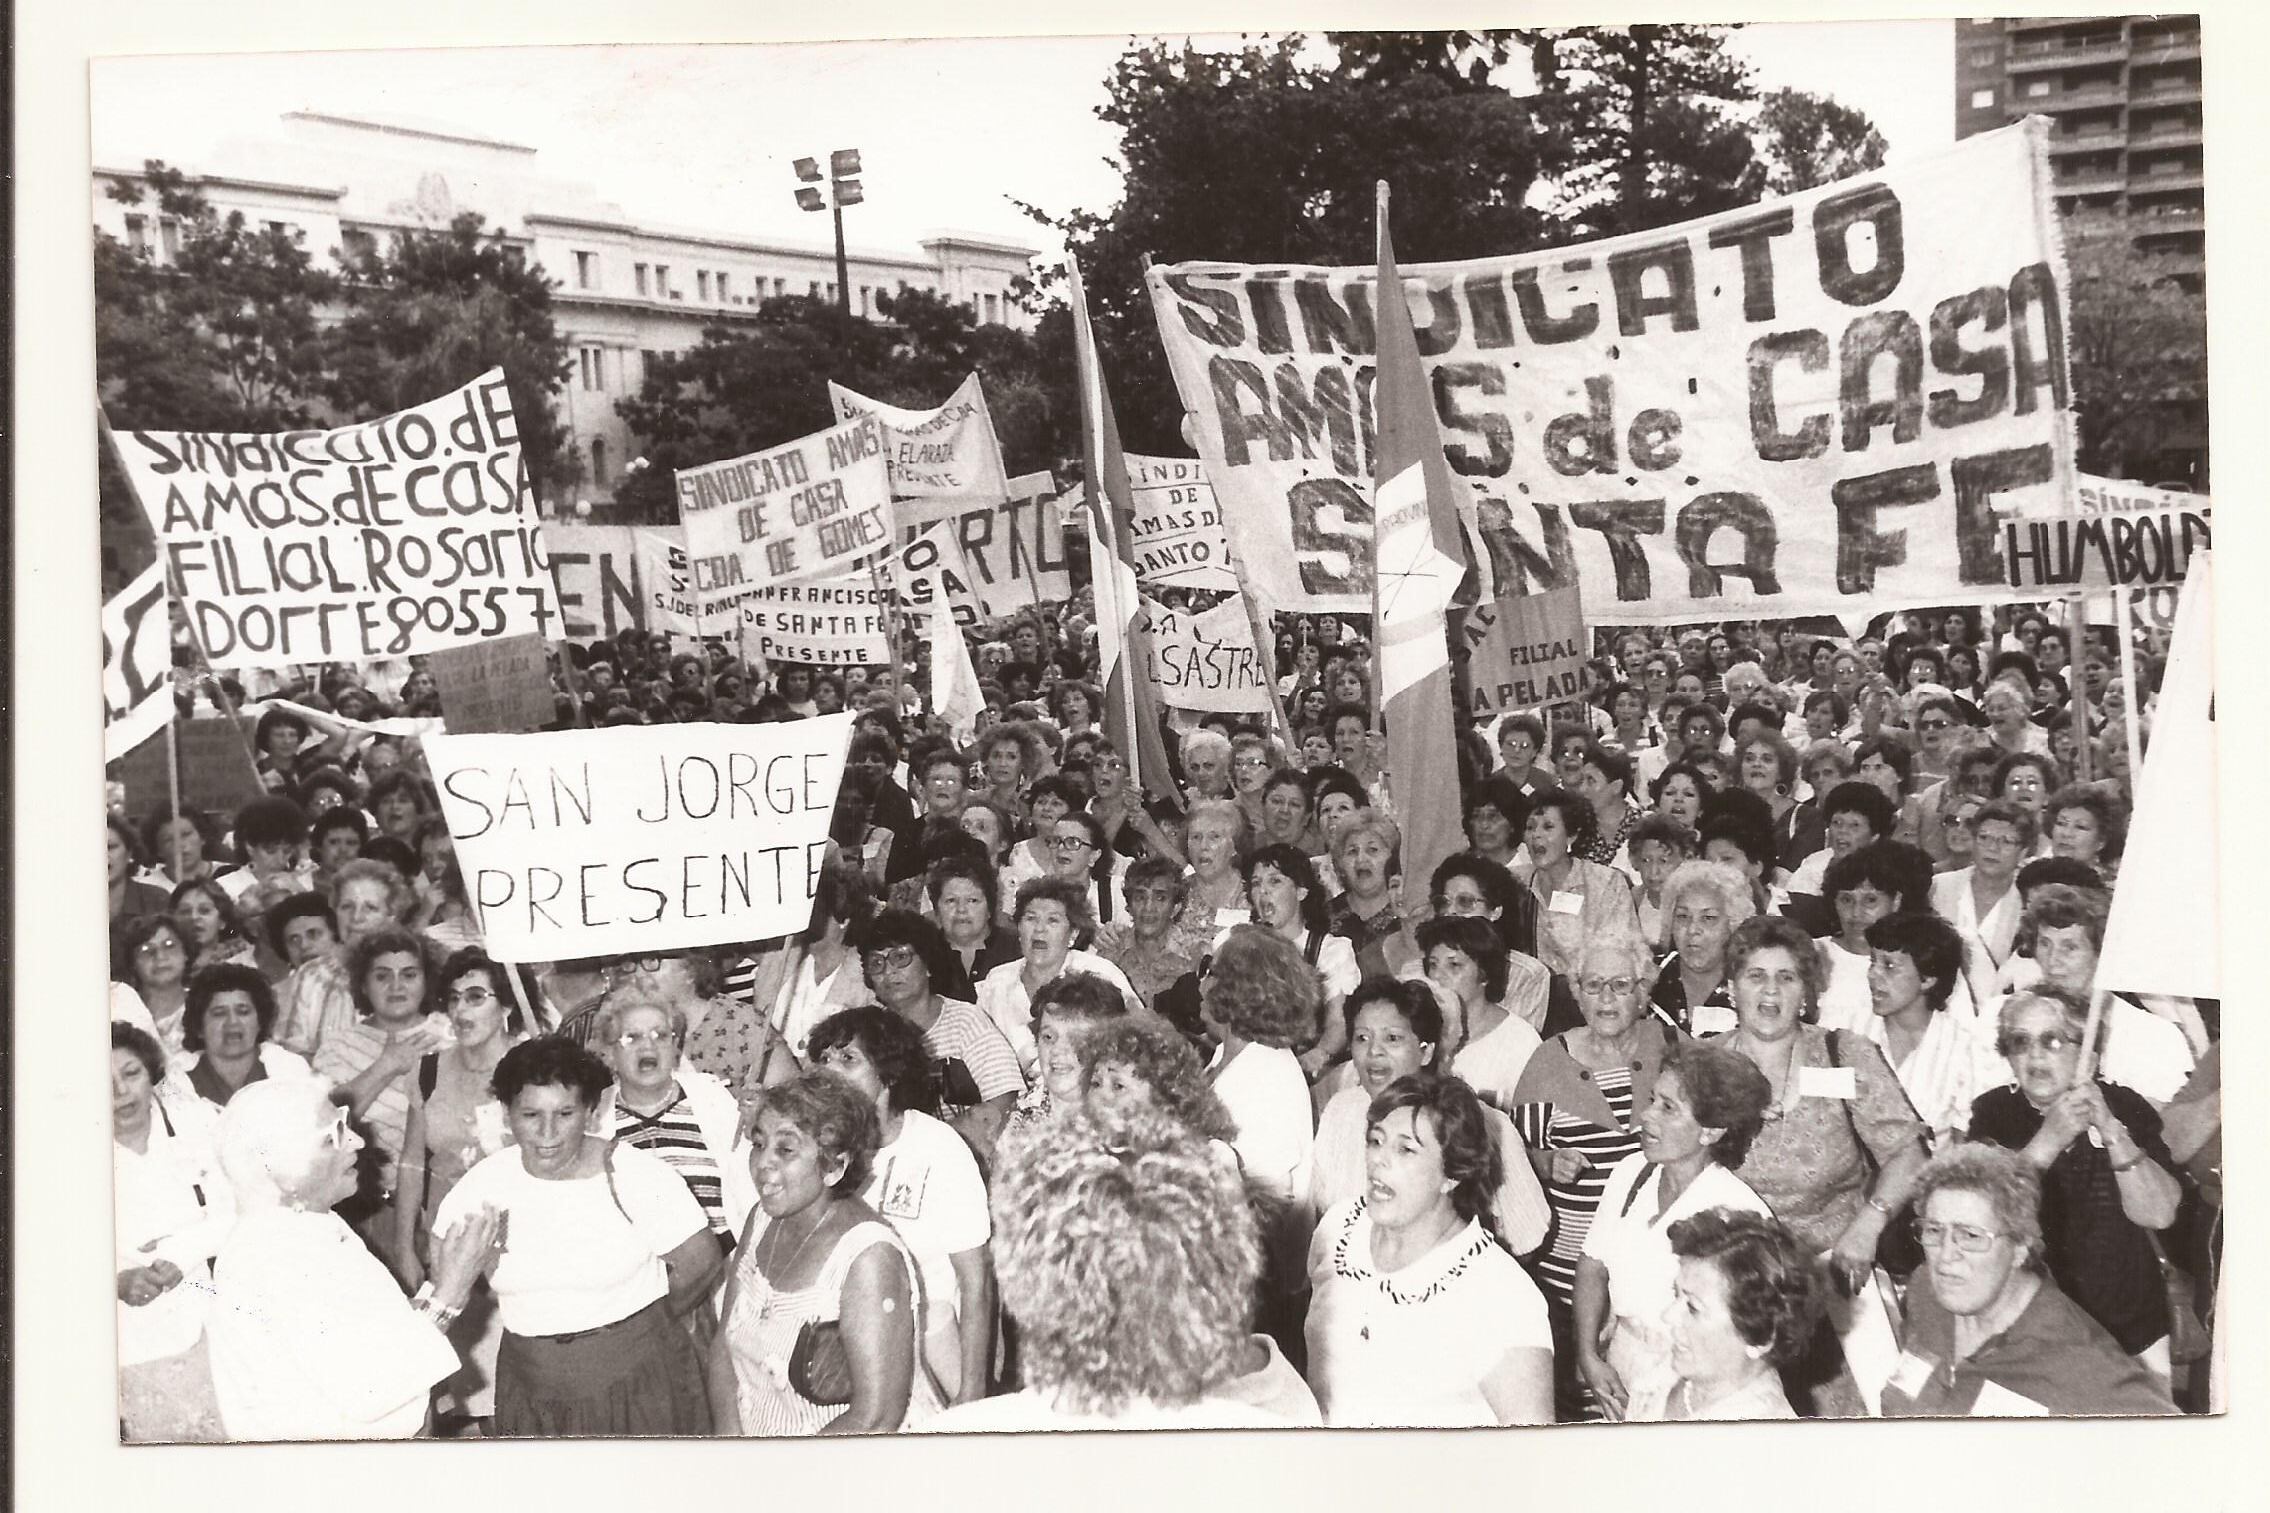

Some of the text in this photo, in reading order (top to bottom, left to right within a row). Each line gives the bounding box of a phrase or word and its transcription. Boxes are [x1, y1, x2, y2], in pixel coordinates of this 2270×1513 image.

[1163, 182, 1905, 356] SINDICATO
[1209, 261, 2069, 478] AMS de CASA
[678, 417, 880, 511] SINDICATO AMAS
[1168, 487, 1199, 505] DE
[737, 478, 848, 544] DE CASA
[1832, 443, 2054, 595] FE
[766, 537, 801, 577] DE
[744, 609, 767, 628] DE
[776, 612, 857, 635] SANTA
[761, 636, 868, 662] PRESENTE
[1510, 639, 1578, 666] FILIAL
[1497, 667, 1589, 708] PELADA
[444, 752, 830, 840] SAN JORGE
[477, 840, 828, 935] PRESENTE
